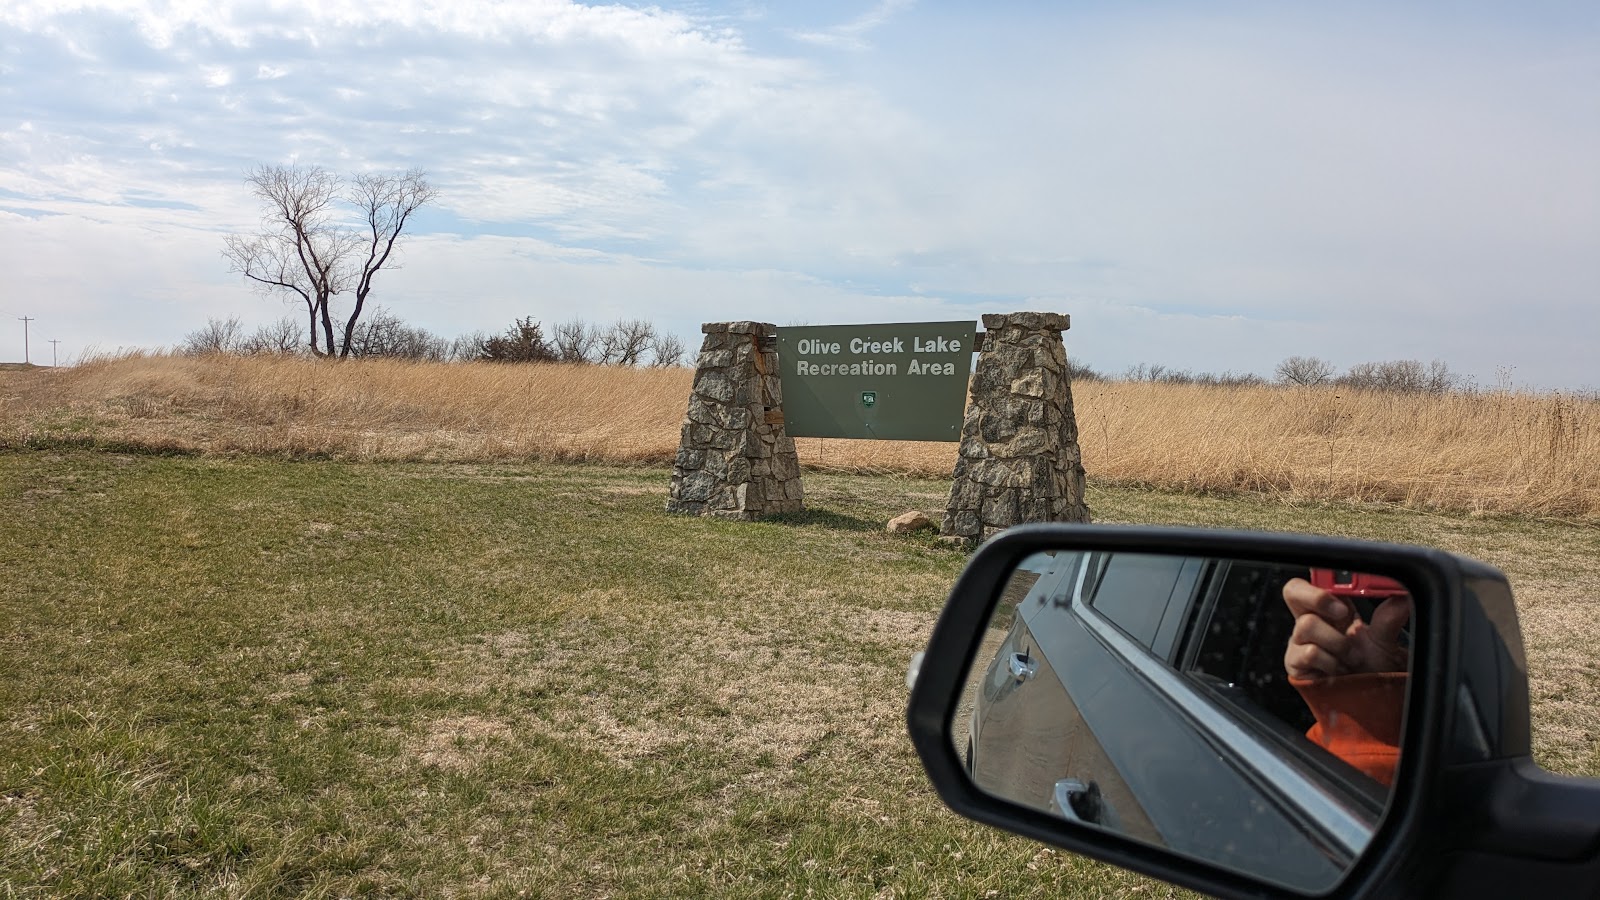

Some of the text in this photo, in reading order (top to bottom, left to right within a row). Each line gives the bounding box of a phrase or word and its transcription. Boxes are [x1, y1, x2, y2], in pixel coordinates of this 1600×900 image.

[798, 336, 961, 355] Olive Creek Lake
[797, 359, 955, 376] Recreation Area
